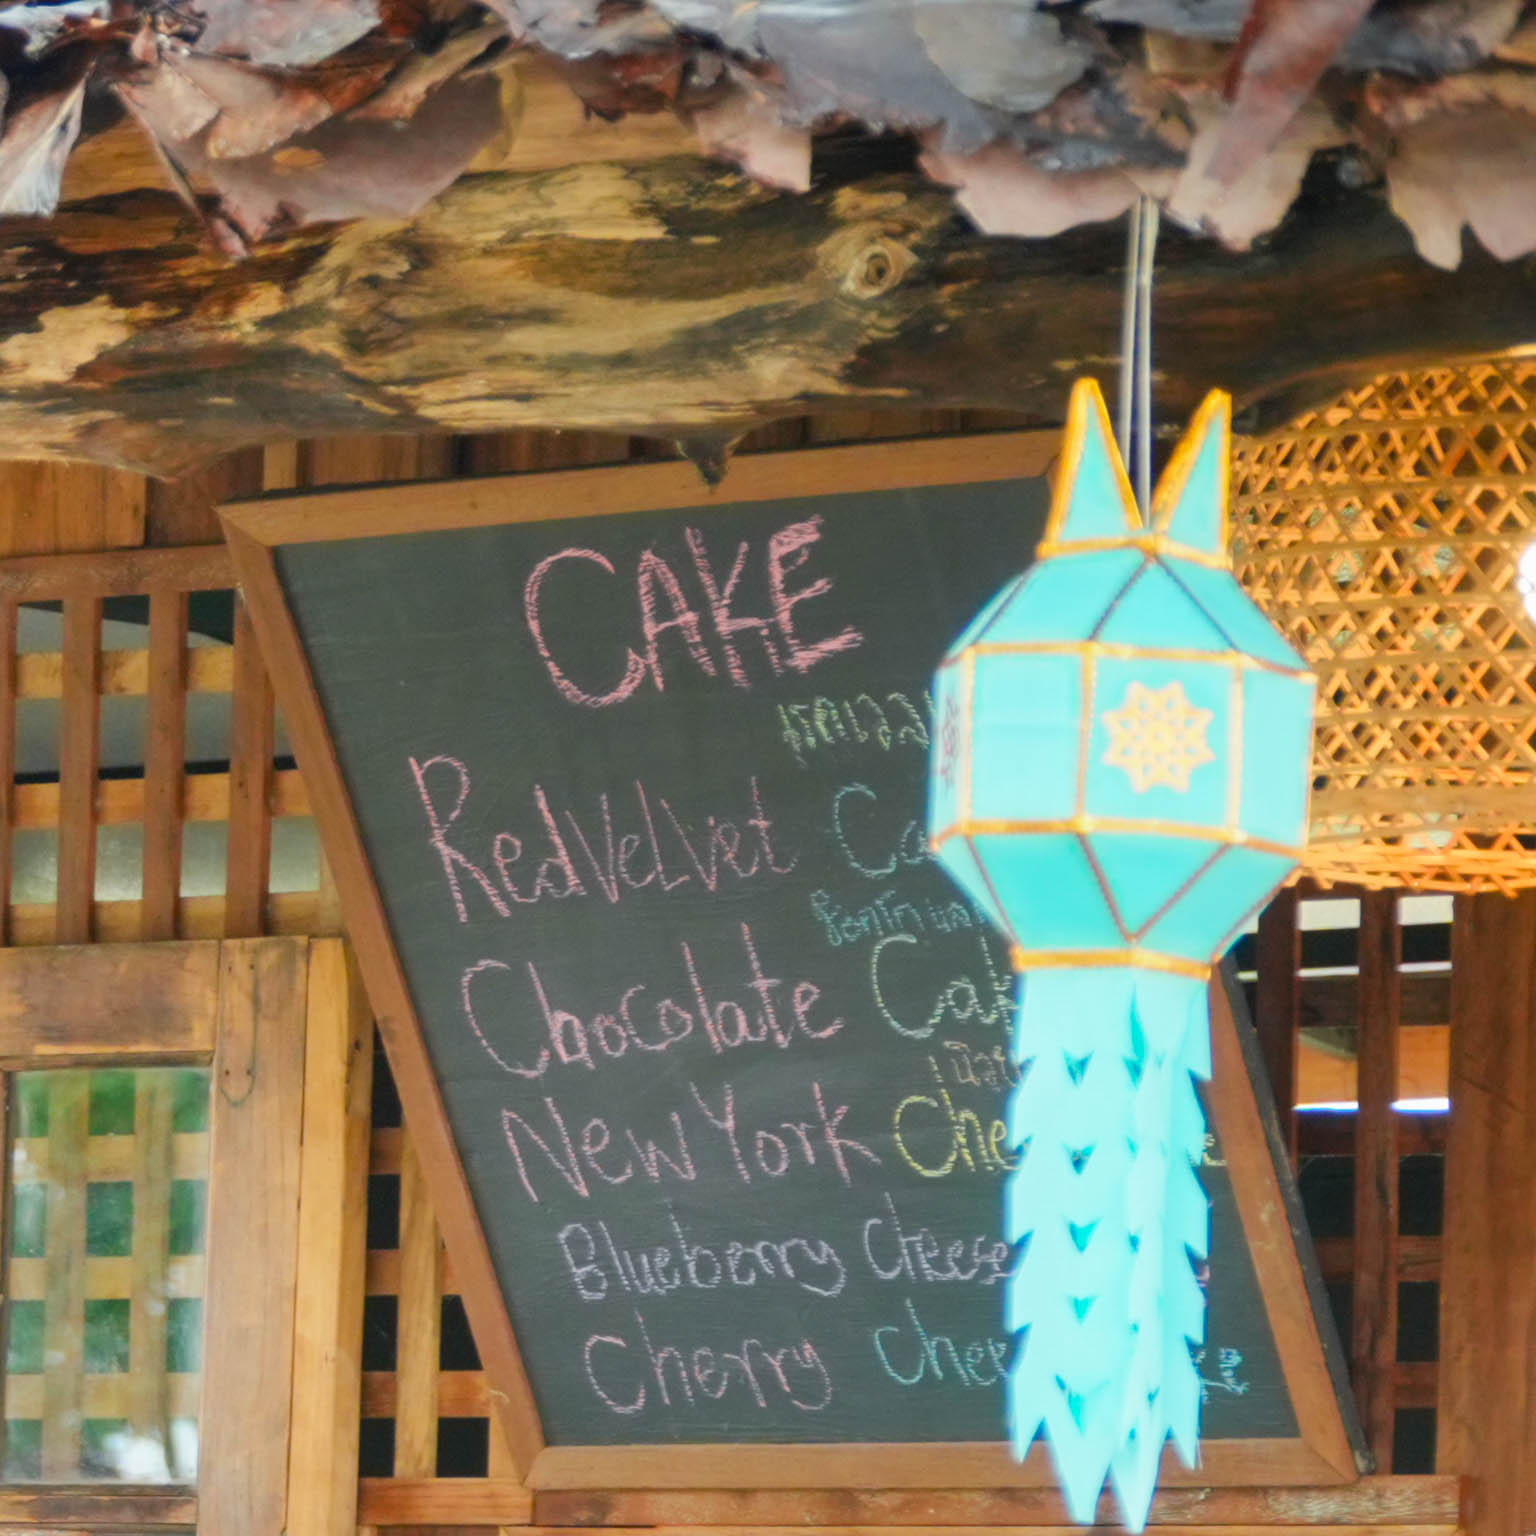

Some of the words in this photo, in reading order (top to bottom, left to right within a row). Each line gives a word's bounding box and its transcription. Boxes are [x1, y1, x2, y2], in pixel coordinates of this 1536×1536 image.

[524, 514, 864, 710] CAKE
[833, 782, 936, 880] Ca
[460, 922, 845, 1078] Chocolate
[872, 933, 1019, 1040] Cak
[893, 1055, 1020, 1178] Che
[557, 1198, 847, 1300] Blueberry
[583, 1307, 833, 1415] Cherry
